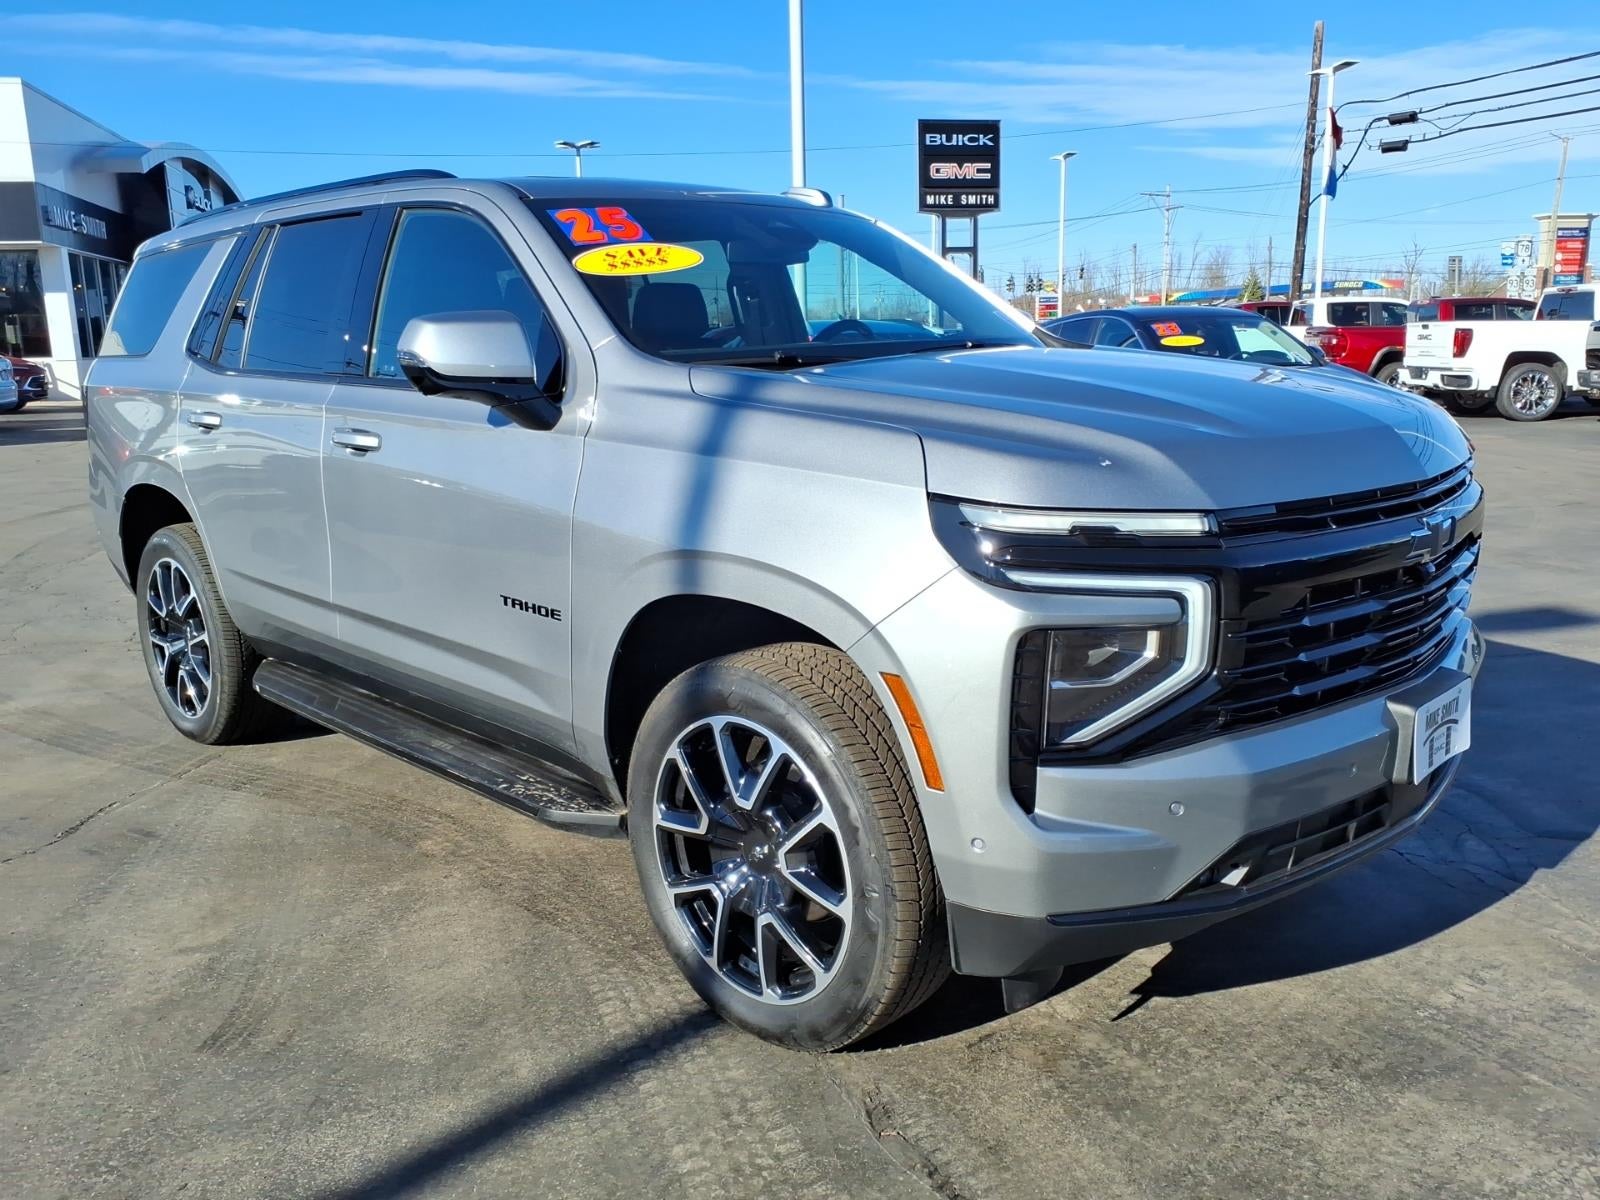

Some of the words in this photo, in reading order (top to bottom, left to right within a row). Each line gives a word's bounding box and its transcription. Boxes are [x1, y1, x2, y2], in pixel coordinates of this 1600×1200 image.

[925, 134, 995, 146] BUICK
[930, 162, 992, 179] GMC
[926, 194, 954, 205] MIKE
[961, 194, 995, 205] SMITH
[53, 205, 78, 232] MIKE
[80, 213, 108, 240] SMITH
[554, 206, 644, 245] 25
[604, 246, 670, 261] SAVE
[1508, 279, 1519, 289] 93
[1524, 279, 1535, 288] 93
[499, 593, 562, 622] TAHOE
